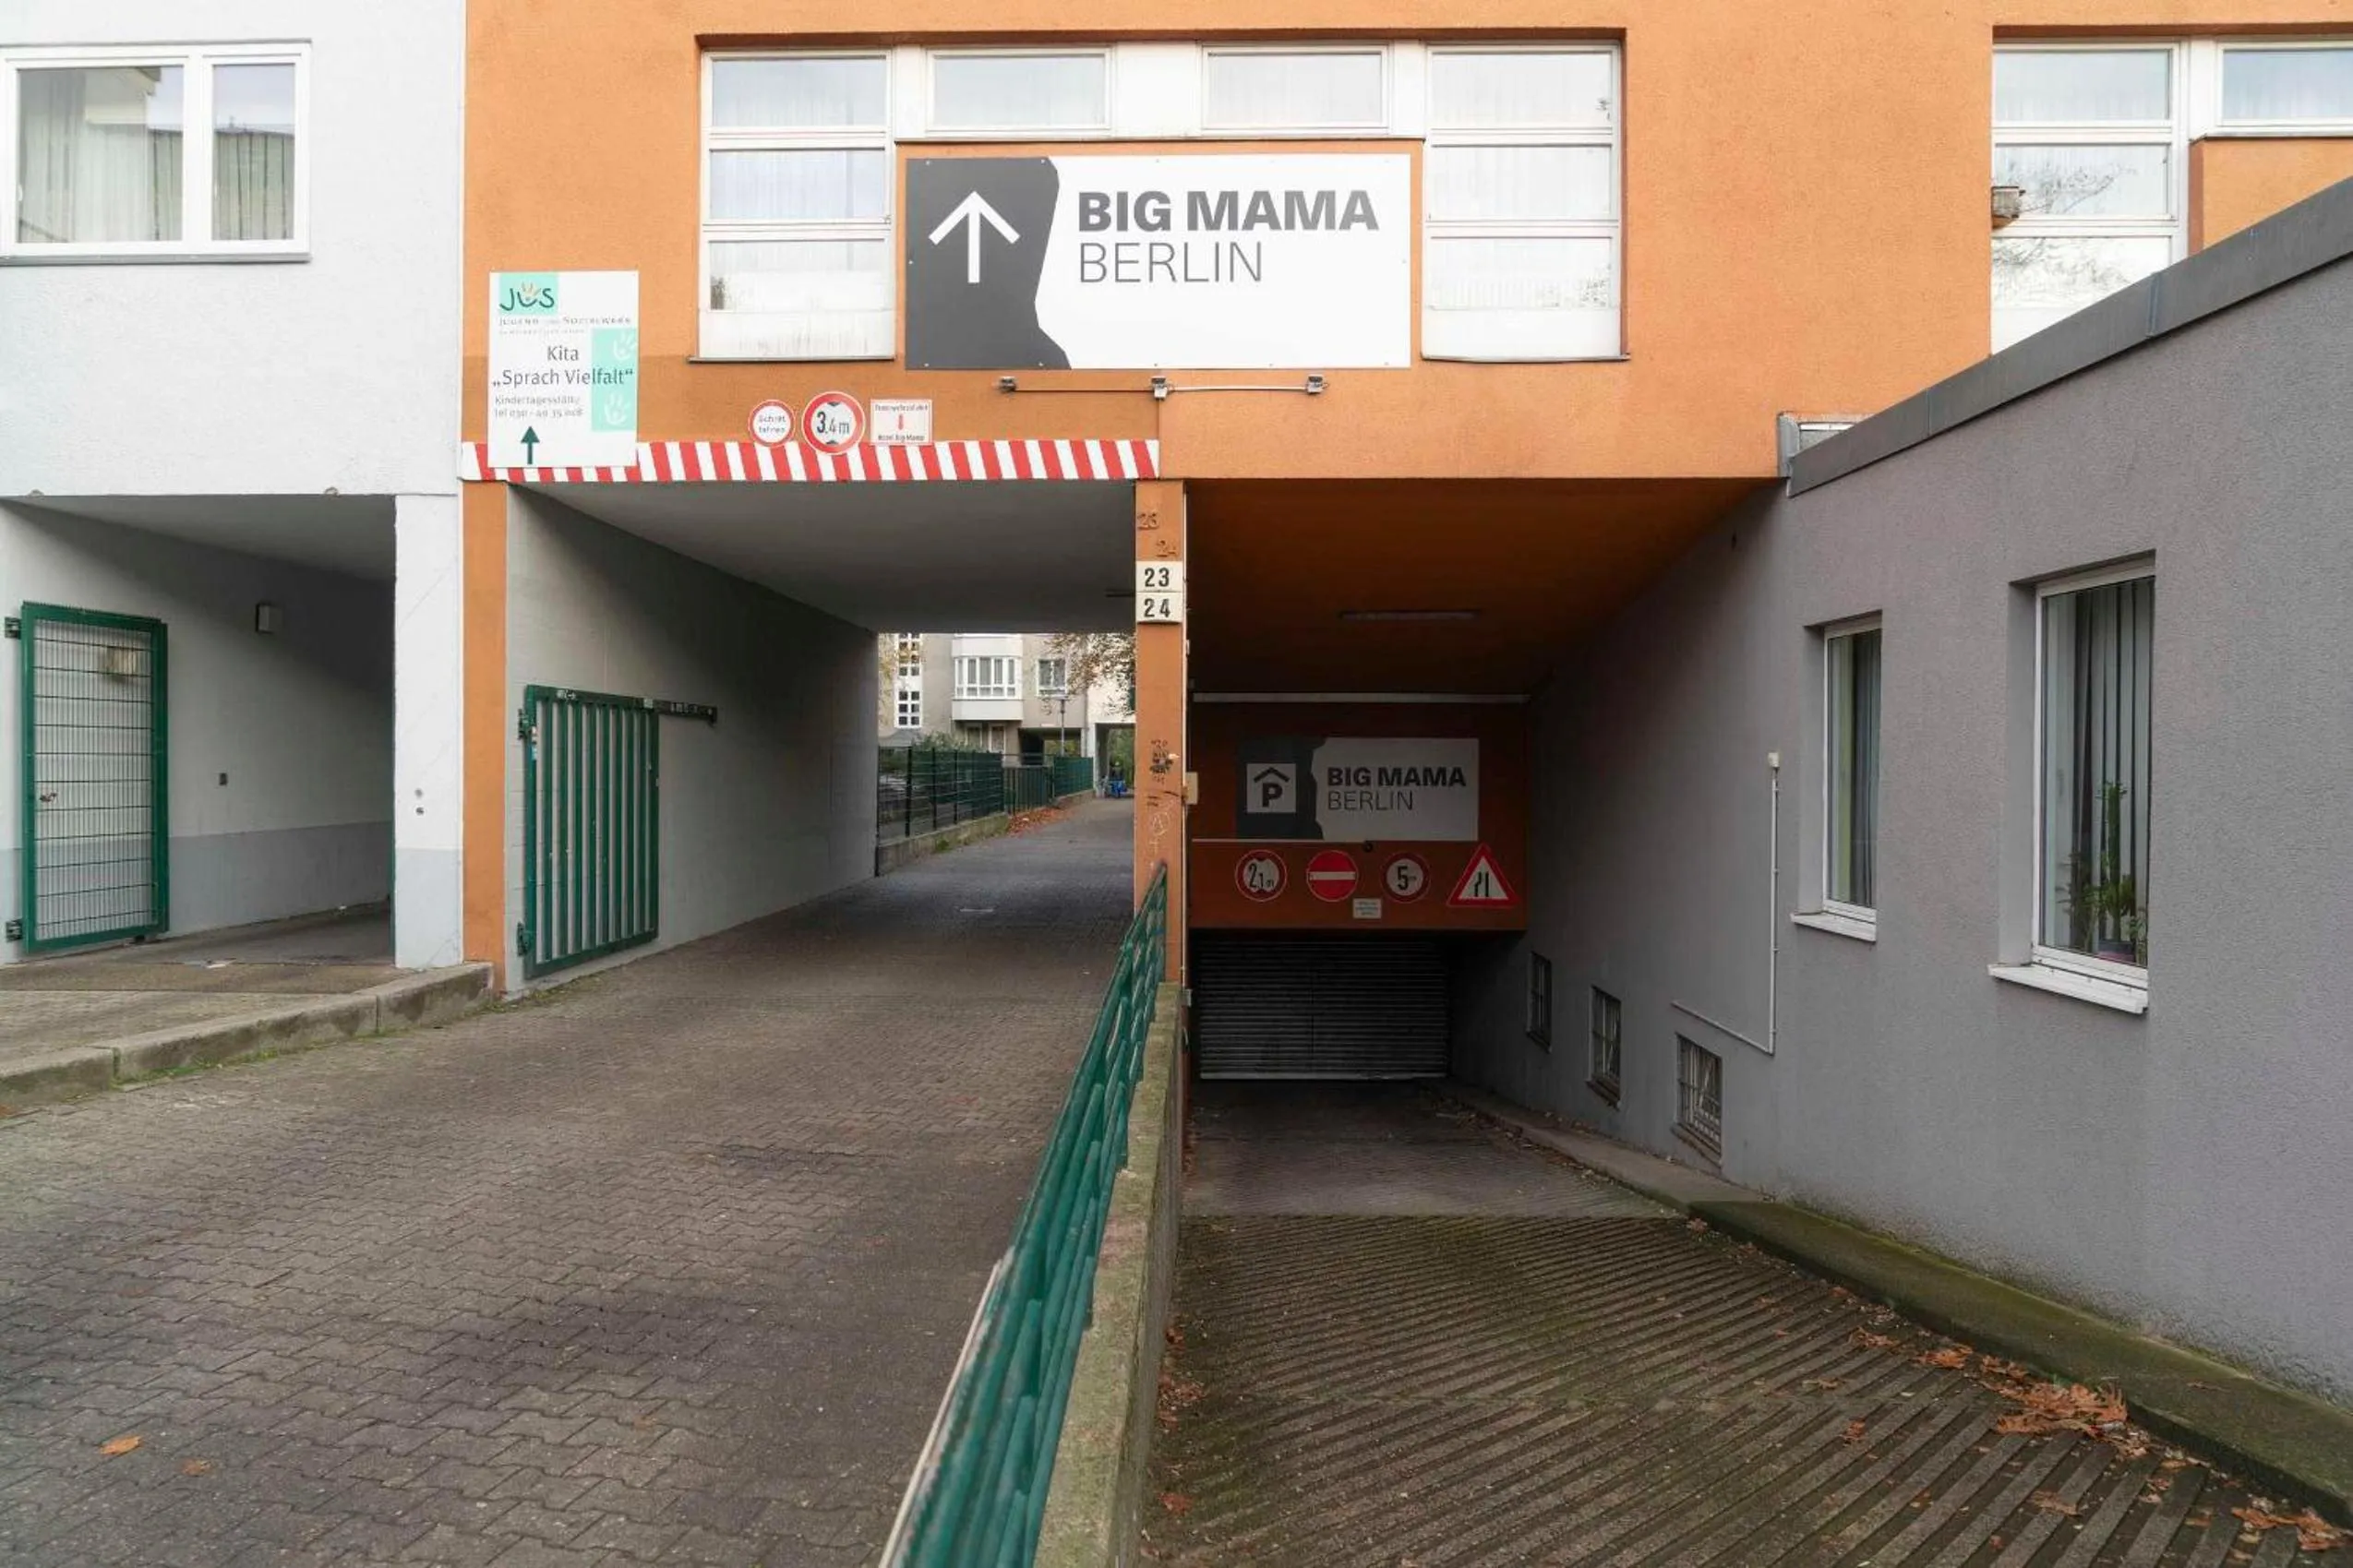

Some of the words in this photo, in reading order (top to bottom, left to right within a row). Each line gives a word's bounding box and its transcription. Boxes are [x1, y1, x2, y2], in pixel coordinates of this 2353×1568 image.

[1078, 190, 1172, 232] BIG
[1187, 190, 1380, 232] MAMA
[1079, 241, 1262, 283] BERLIN
[546, 345, 580, 362] Kita
[1144, 568, 1170, 588] 23
[1144, 598, 1171, 618] 24
[1327, 766, 1372, 787] BIG
[1377, 766, 1467, 787] MAMA
[1262, 783, 1283, 808] P
[1327, 790, 1414, 810] BERLIN
